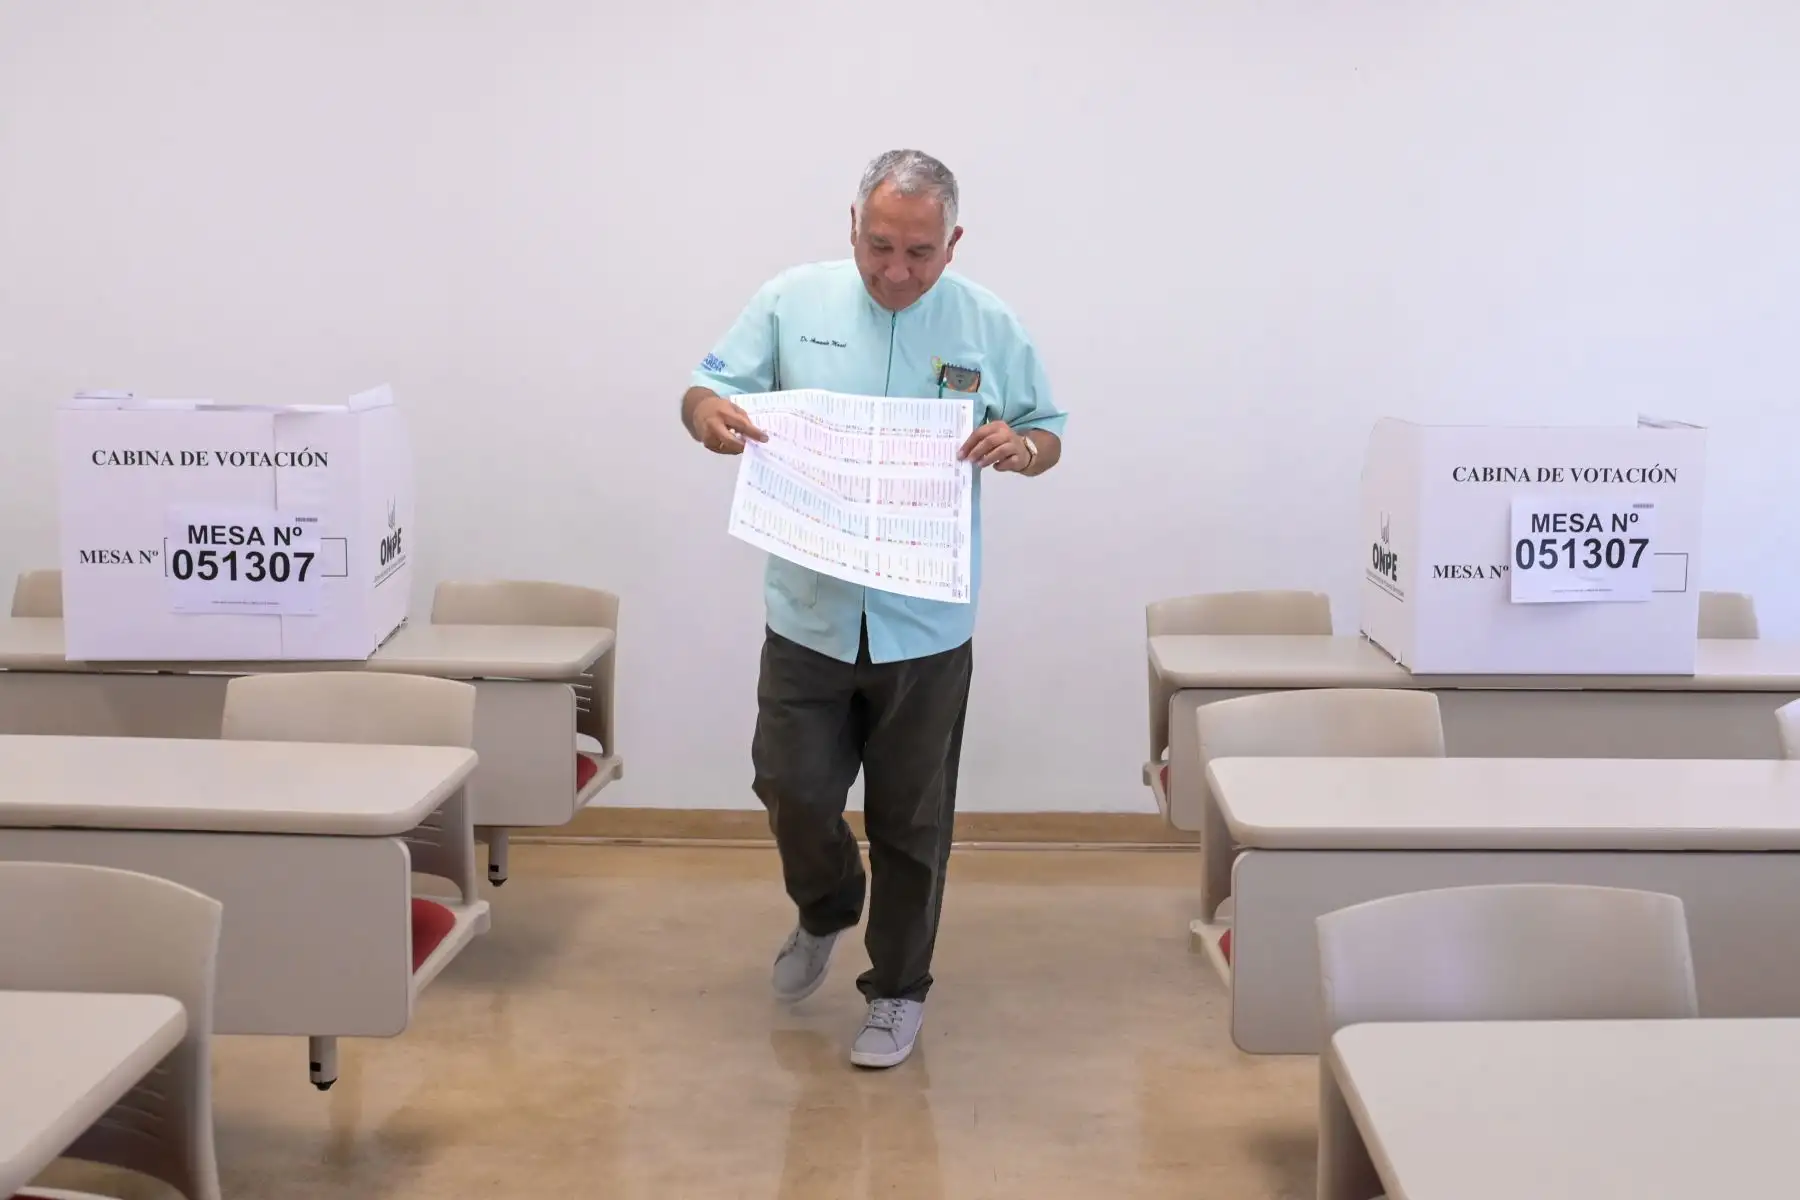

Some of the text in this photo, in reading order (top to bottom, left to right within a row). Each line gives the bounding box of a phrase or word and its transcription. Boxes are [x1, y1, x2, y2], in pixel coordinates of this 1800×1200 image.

[91, 446, 329, 468] CABINA DE VOTACIÓN
[1452, 463, 1679, 484] CABINA DE VOTACIÓN
[1531, 512, 1604, 534] MESA
[187, 524, 266, 547] MESA
[380, 526, 402, 567] ONPE
[79, 549, 134, 565] MESA
[1372, 541, 1398, 582] ONPE
[1515, 537, 1650, 570] 051307
[172, 548, 316, 583] 051307
[1432, 564, 1485, 580] MESA
